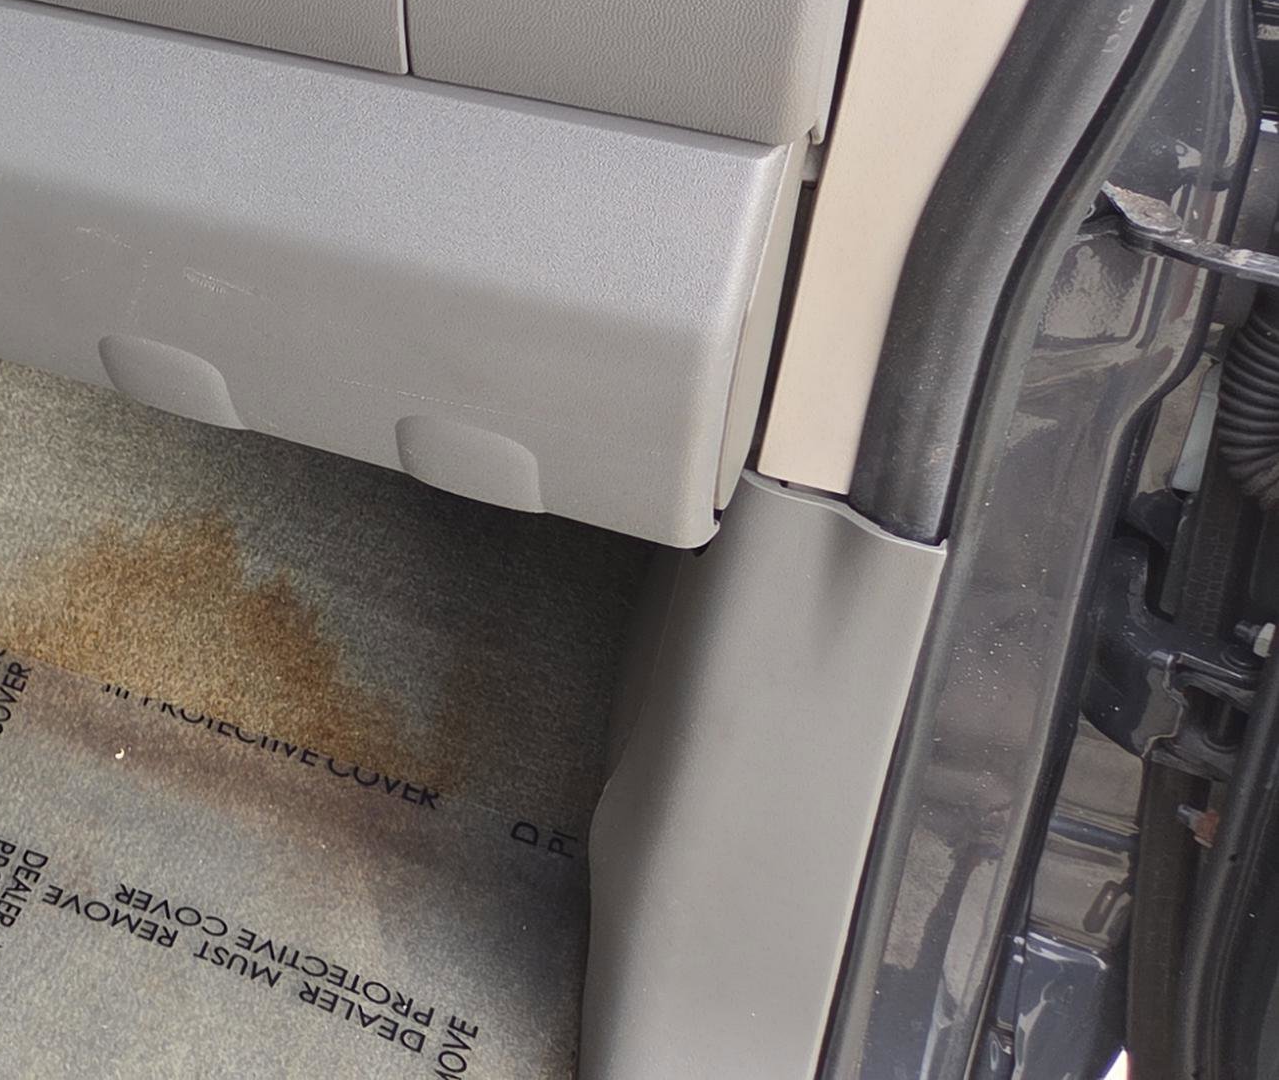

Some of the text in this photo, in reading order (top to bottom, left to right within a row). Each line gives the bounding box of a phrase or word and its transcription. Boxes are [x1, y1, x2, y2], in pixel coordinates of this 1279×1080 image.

[42, 884, 426, 1053] DEALER MUST REMOVE
[114, 883, 435, 1027] PROTECTIVE COVER
